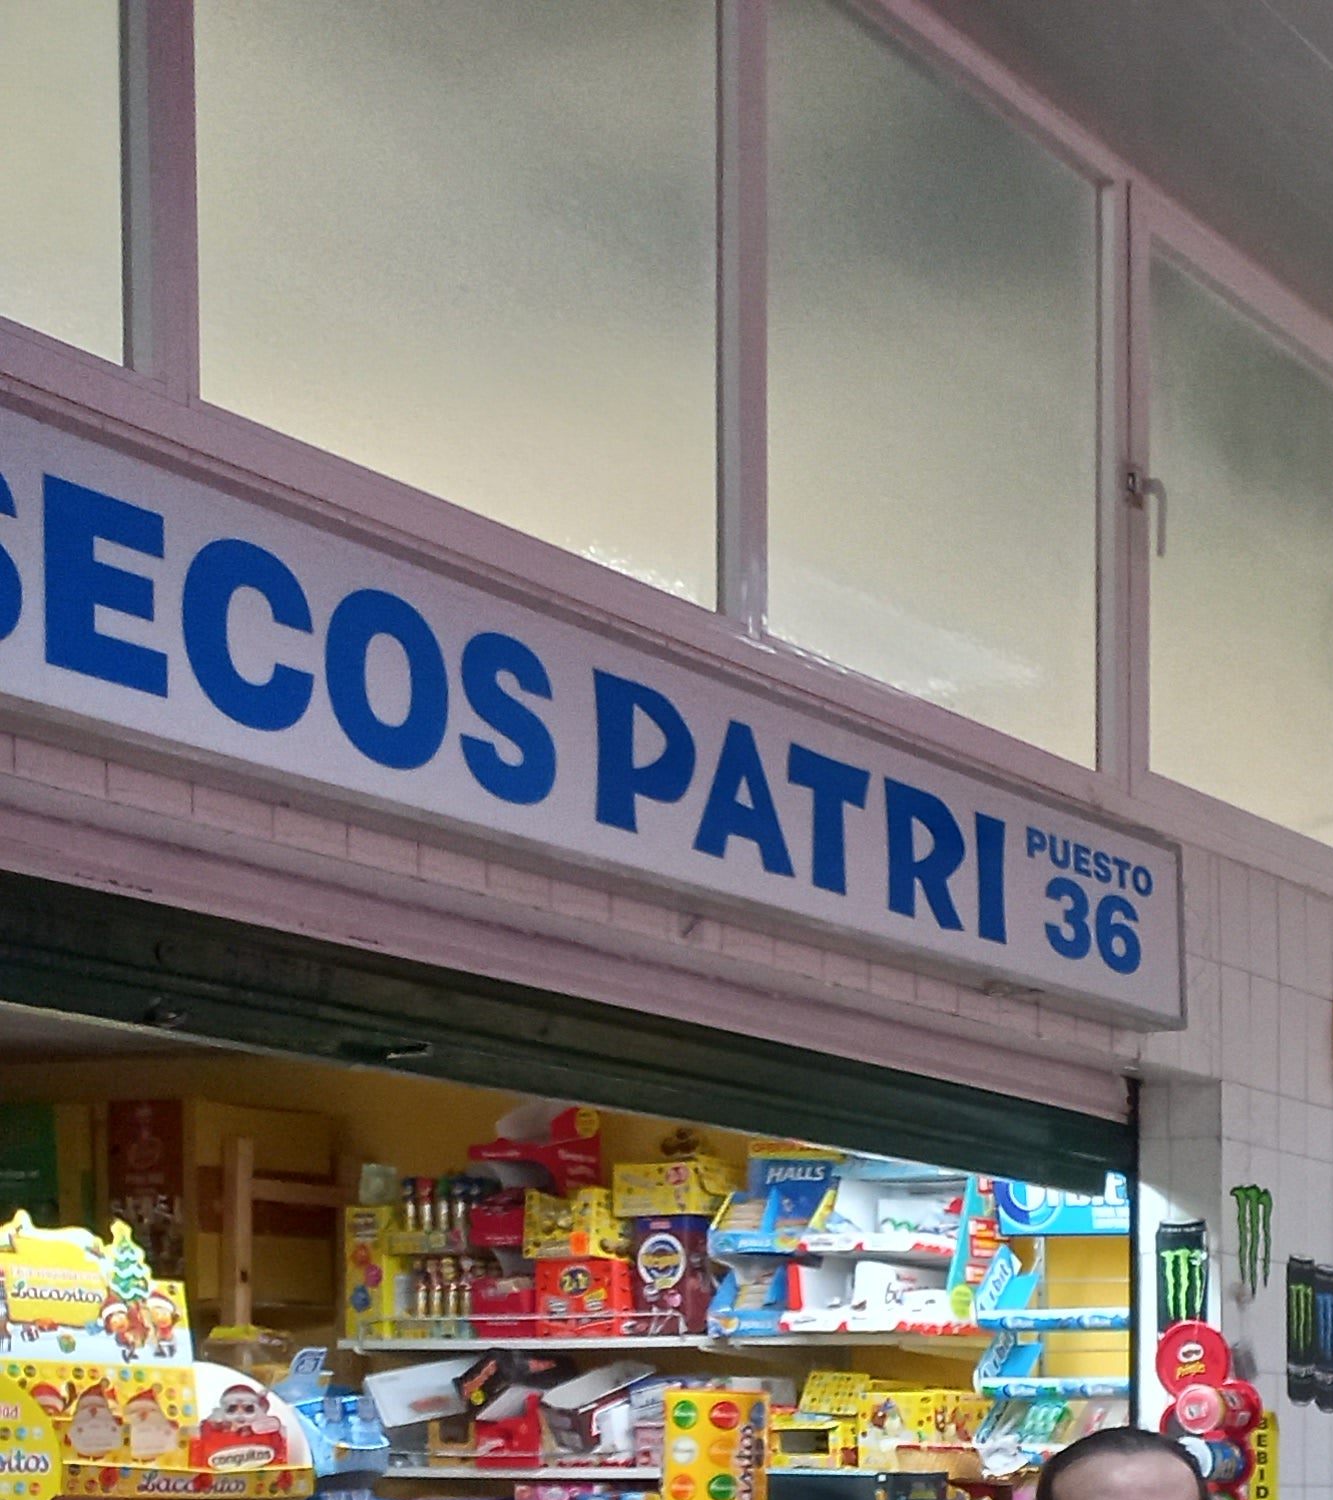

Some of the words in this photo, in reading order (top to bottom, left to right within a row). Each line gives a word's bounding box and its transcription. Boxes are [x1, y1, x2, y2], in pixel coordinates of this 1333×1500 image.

[0, 472, 556, 804] ECOS
[596, 668, 1007, 945] PATRI
[1025, 824, 1154, 897] PUESTO
[1043, 876, 1142, 975] 36
[765, 1166, 826, 1185] HALLS
[11, 1280, 104, 1303] Lacasitos
